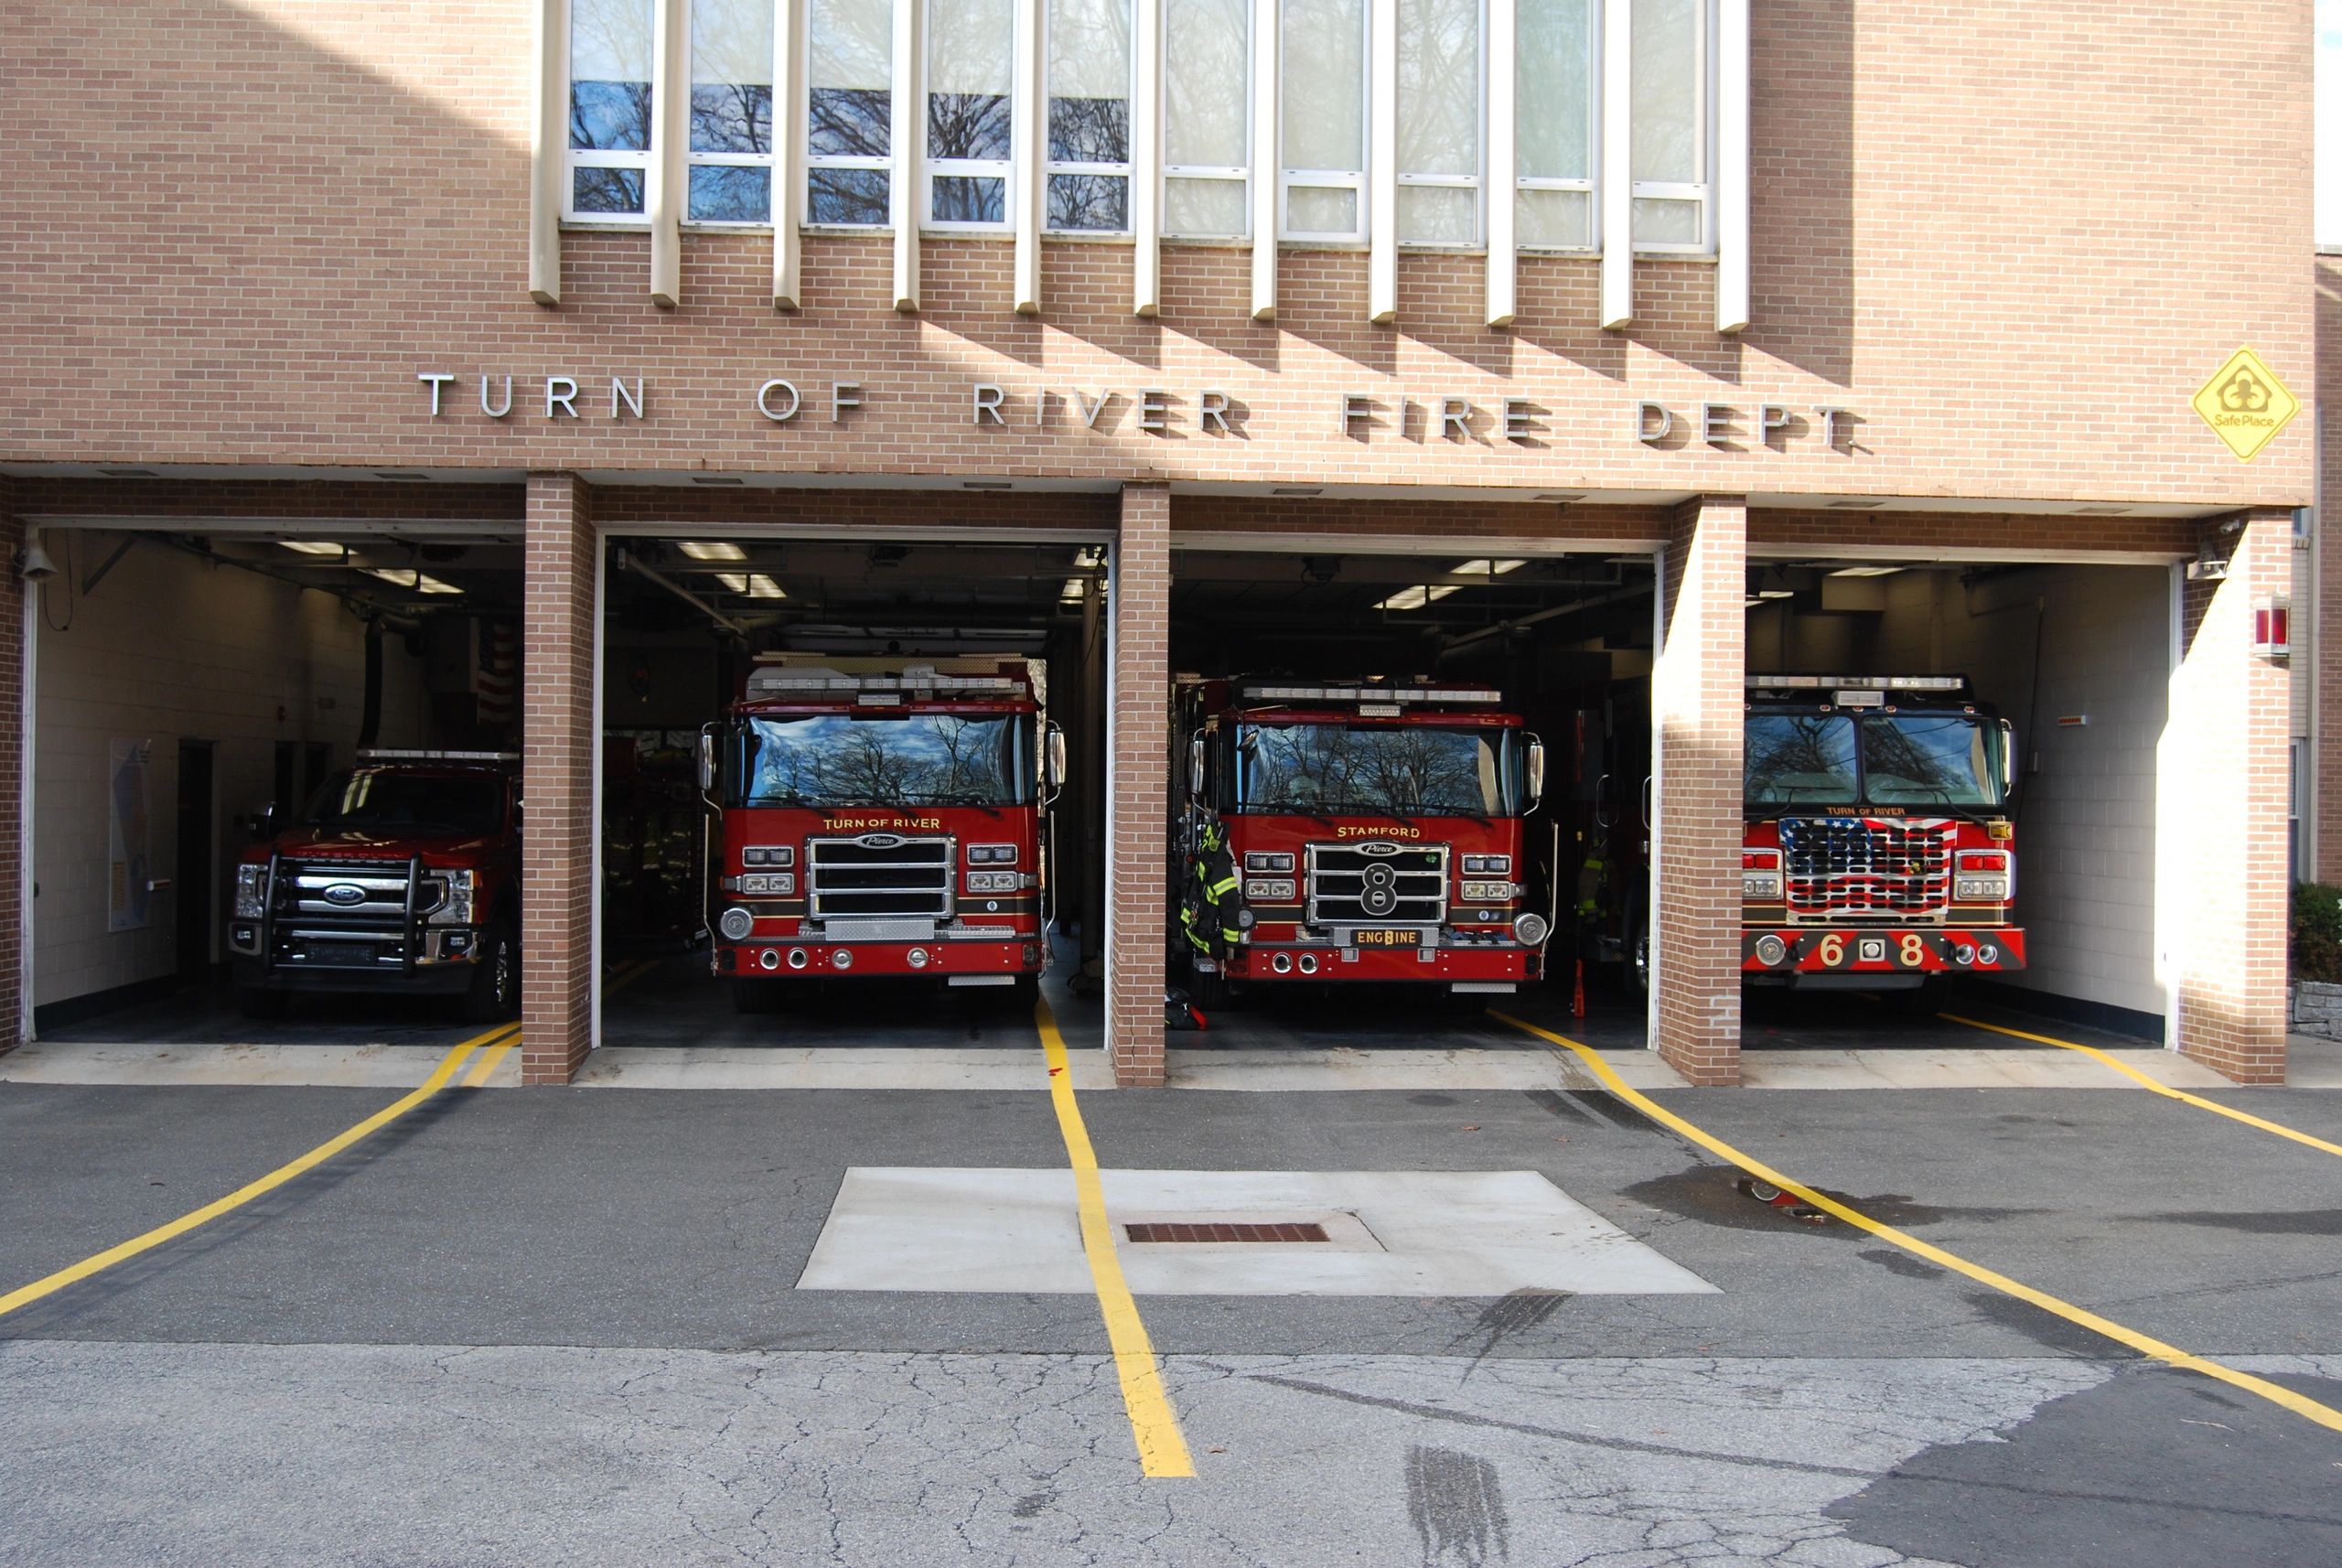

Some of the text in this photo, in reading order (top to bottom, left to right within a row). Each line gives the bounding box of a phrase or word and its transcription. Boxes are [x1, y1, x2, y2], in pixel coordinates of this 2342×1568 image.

[418, 373, 644, 419] TURN
[757, 379, 860, 423] OF
[973, 382, 1230, 431] RIVER
[1342, 394, 1530, 438] FIRE
[1826, 807, 1855, 816] TURN
[1875, 807, 1906, 816] RIVER
[823, 818, 940, 831] TURN OF RIVER
[1338, 826, 1420, 839] STAMFORD
[865, 835, 895, 846] Pierce
[1365, 843, 1393, 856] Pierce
[1360, 863, 1397, 917] 8
[1820, 933, 1924, 967] 6 8
